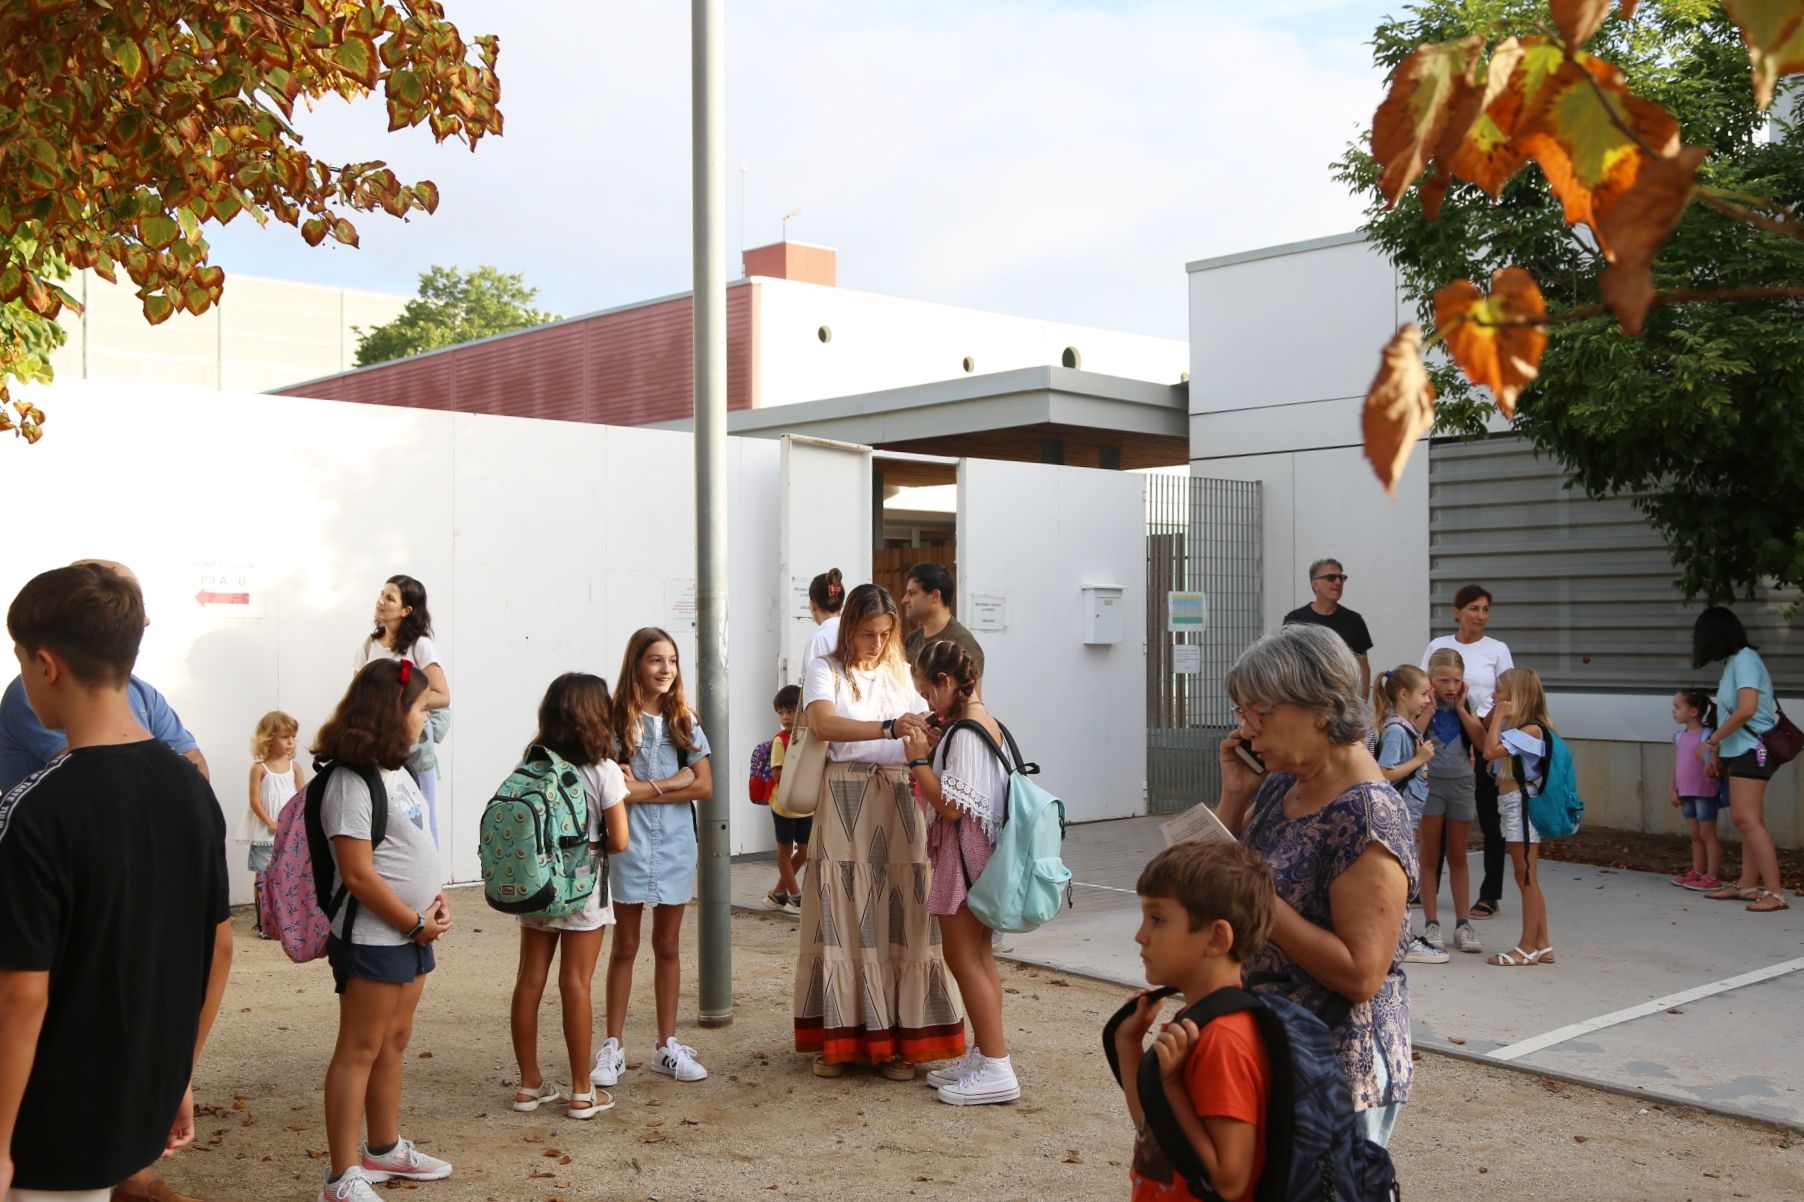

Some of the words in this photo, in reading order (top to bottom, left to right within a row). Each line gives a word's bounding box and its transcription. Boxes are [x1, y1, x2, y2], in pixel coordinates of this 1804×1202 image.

[200, 575, 216, 585] P3
[219, 575, 228, 585] A
[238, 576, 247, 586] B
